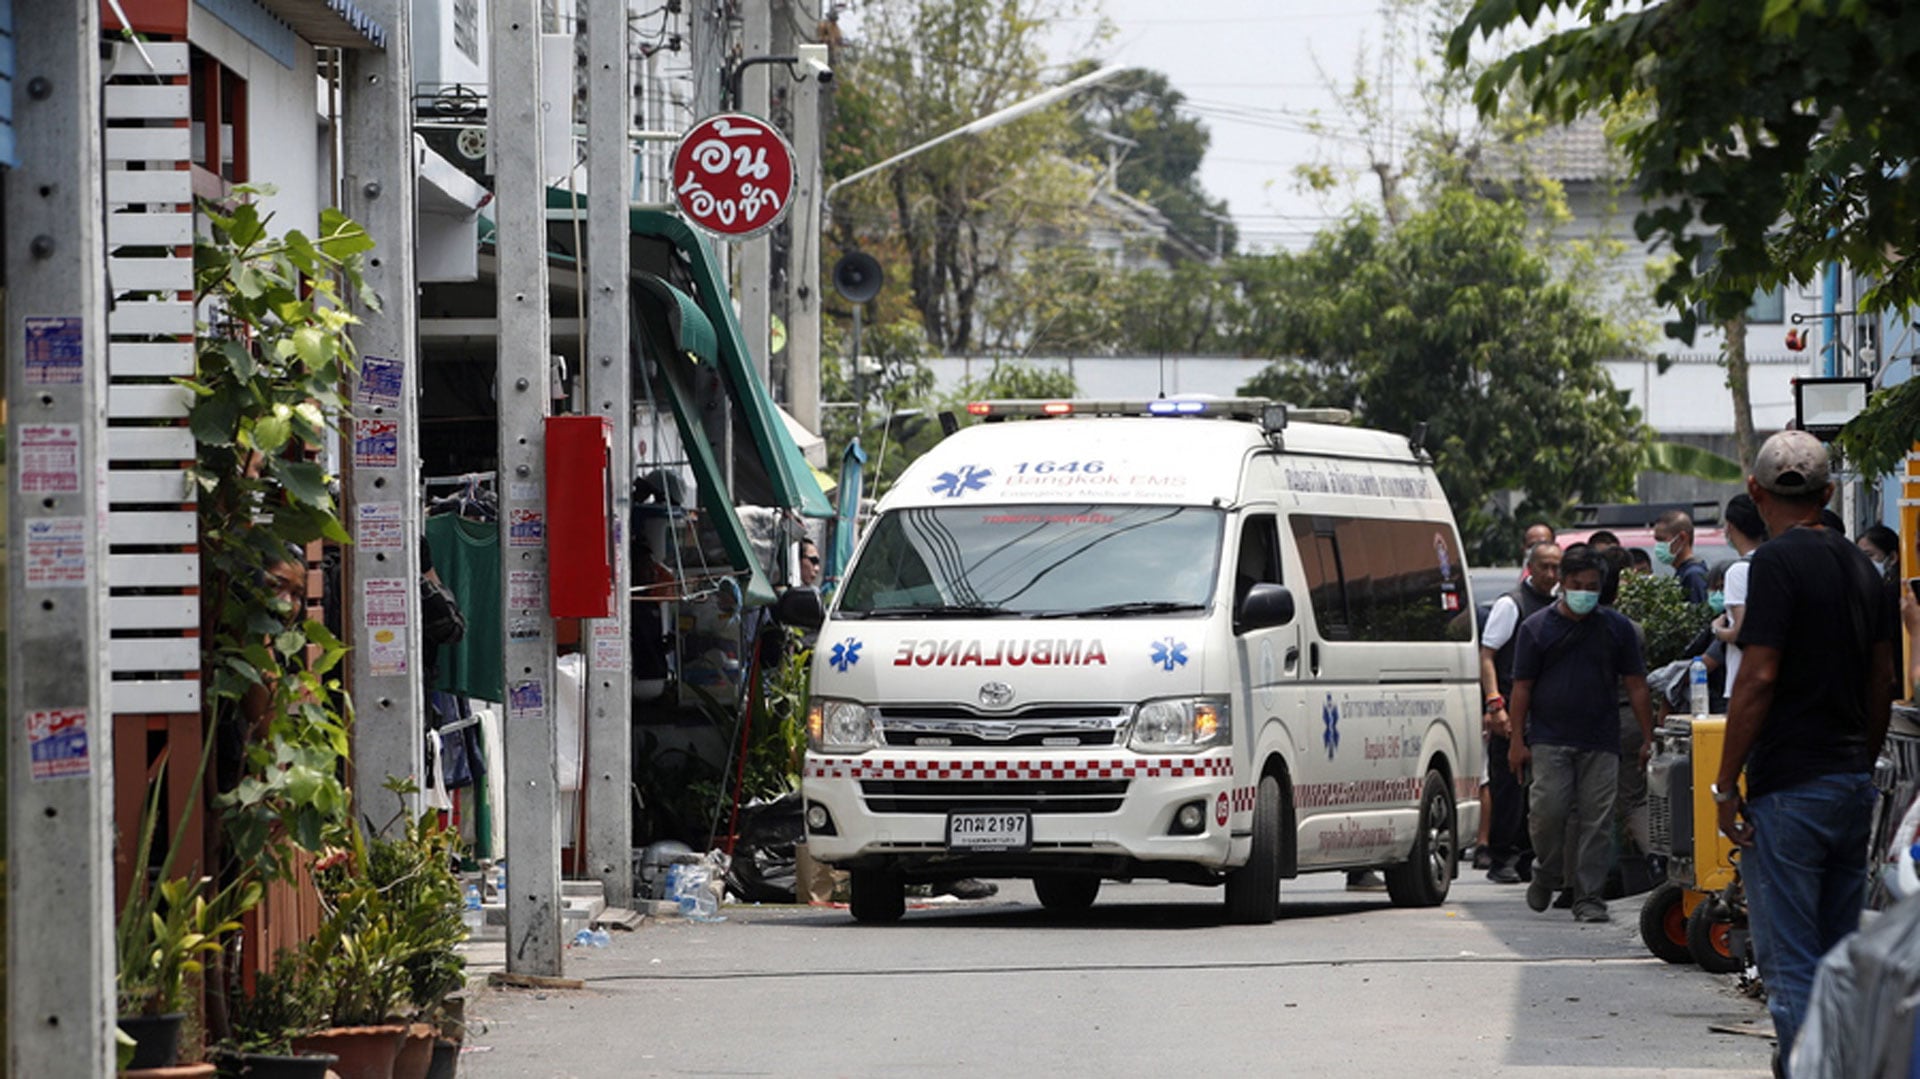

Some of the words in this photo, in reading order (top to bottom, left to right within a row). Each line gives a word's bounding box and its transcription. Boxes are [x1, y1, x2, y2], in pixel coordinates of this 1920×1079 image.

[1013, 460, 1105, 474] 1646
[1005, 472, 1120, 487] Bangkok
[1129, 474, 1187, 487] EMS
[988, 816, 1025, 833] 2197
